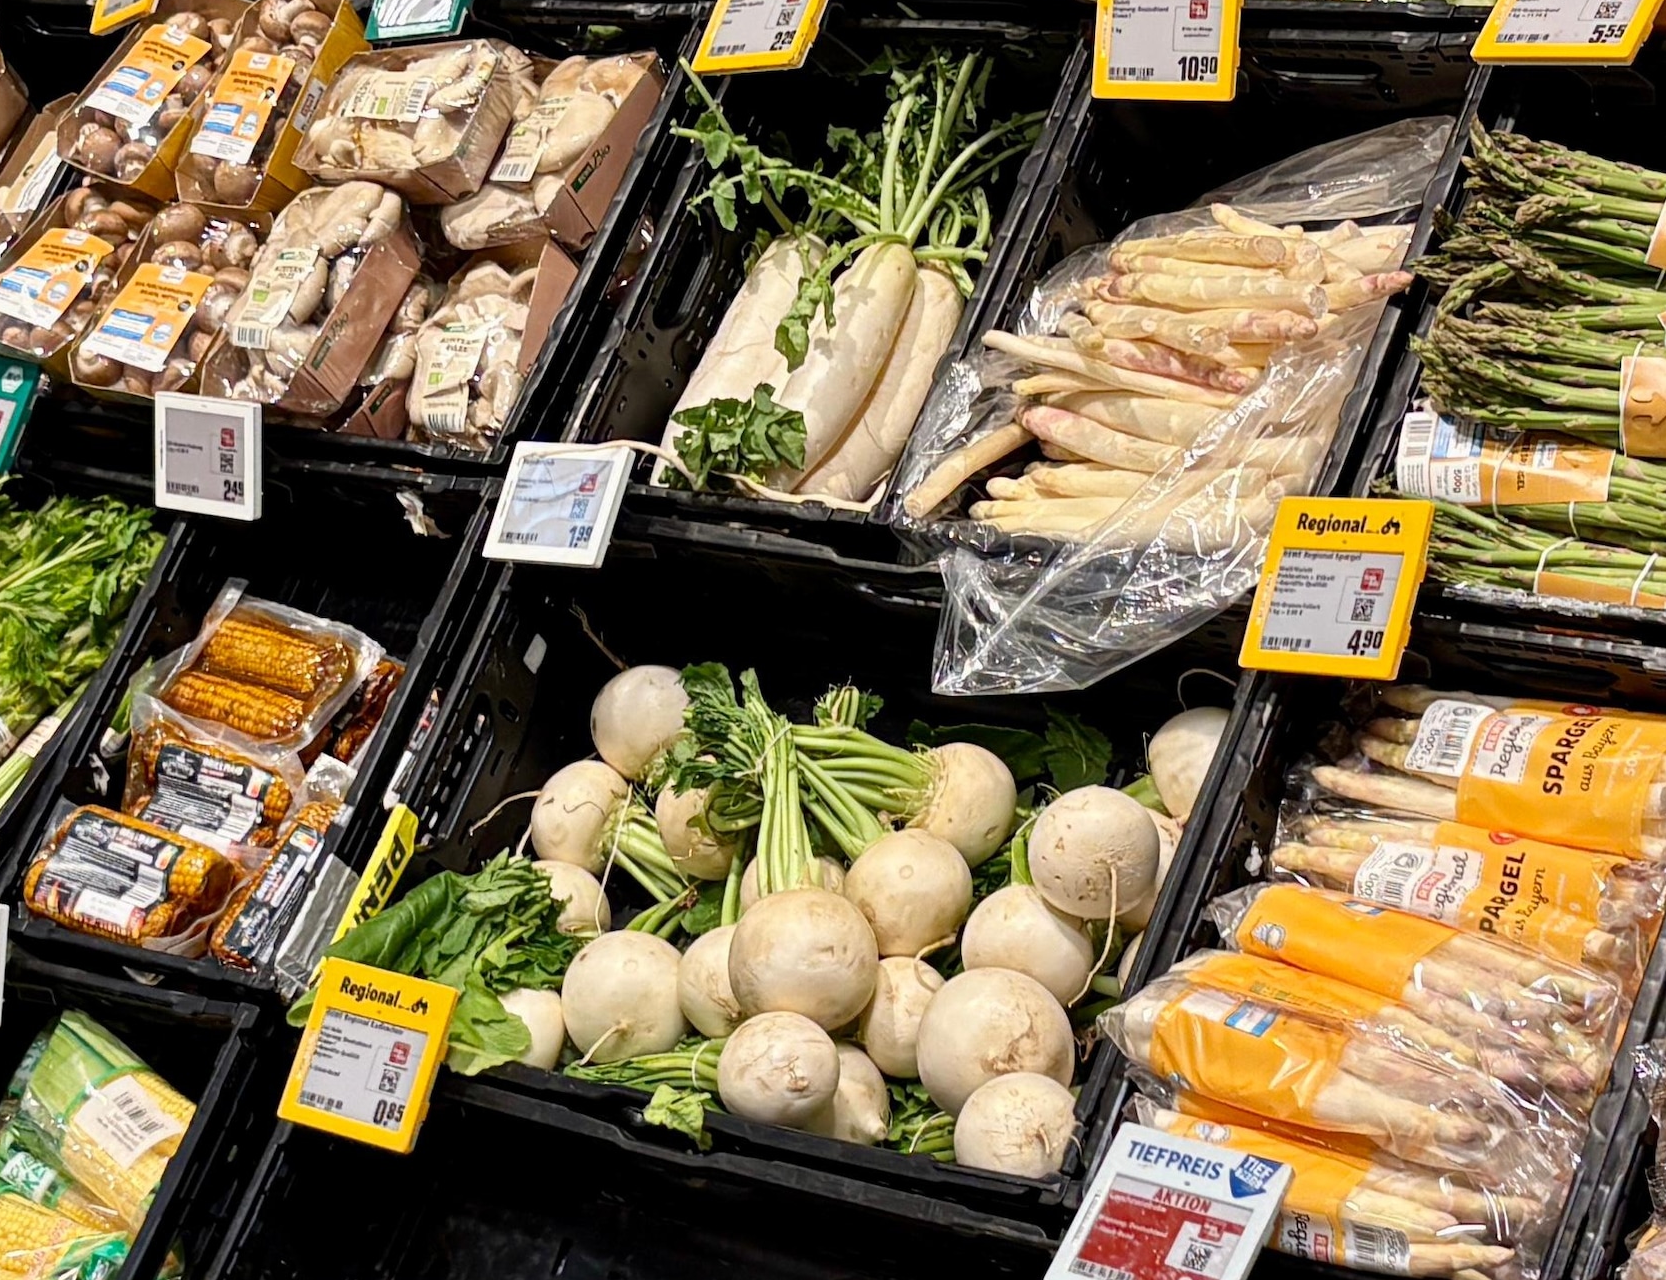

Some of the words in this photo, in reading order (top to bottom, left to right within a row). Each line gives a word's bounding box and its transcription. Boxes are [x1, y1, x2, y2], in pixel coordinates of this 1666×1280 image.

[1588, 24, 1628, 43] 5.55
[1177, 55, 1219, 82] 10.90
[1297, 512, 1367, 536] Regional
[1347, 629, 1384, 656] 4.90
[1542, 715, 1603, 796] SPARGEL
[1478, 851, 1527, 936] PARGEL
[340, 975, 401, 1009] Regional
[373, 1099, 407, 1128] 0.85
[1127, 1139, 1224, 1181] TIEFPREIS
[1242, 1155, 1274, 1180] TIEF
[1153, 1187, 1213, 1215] AKTION
